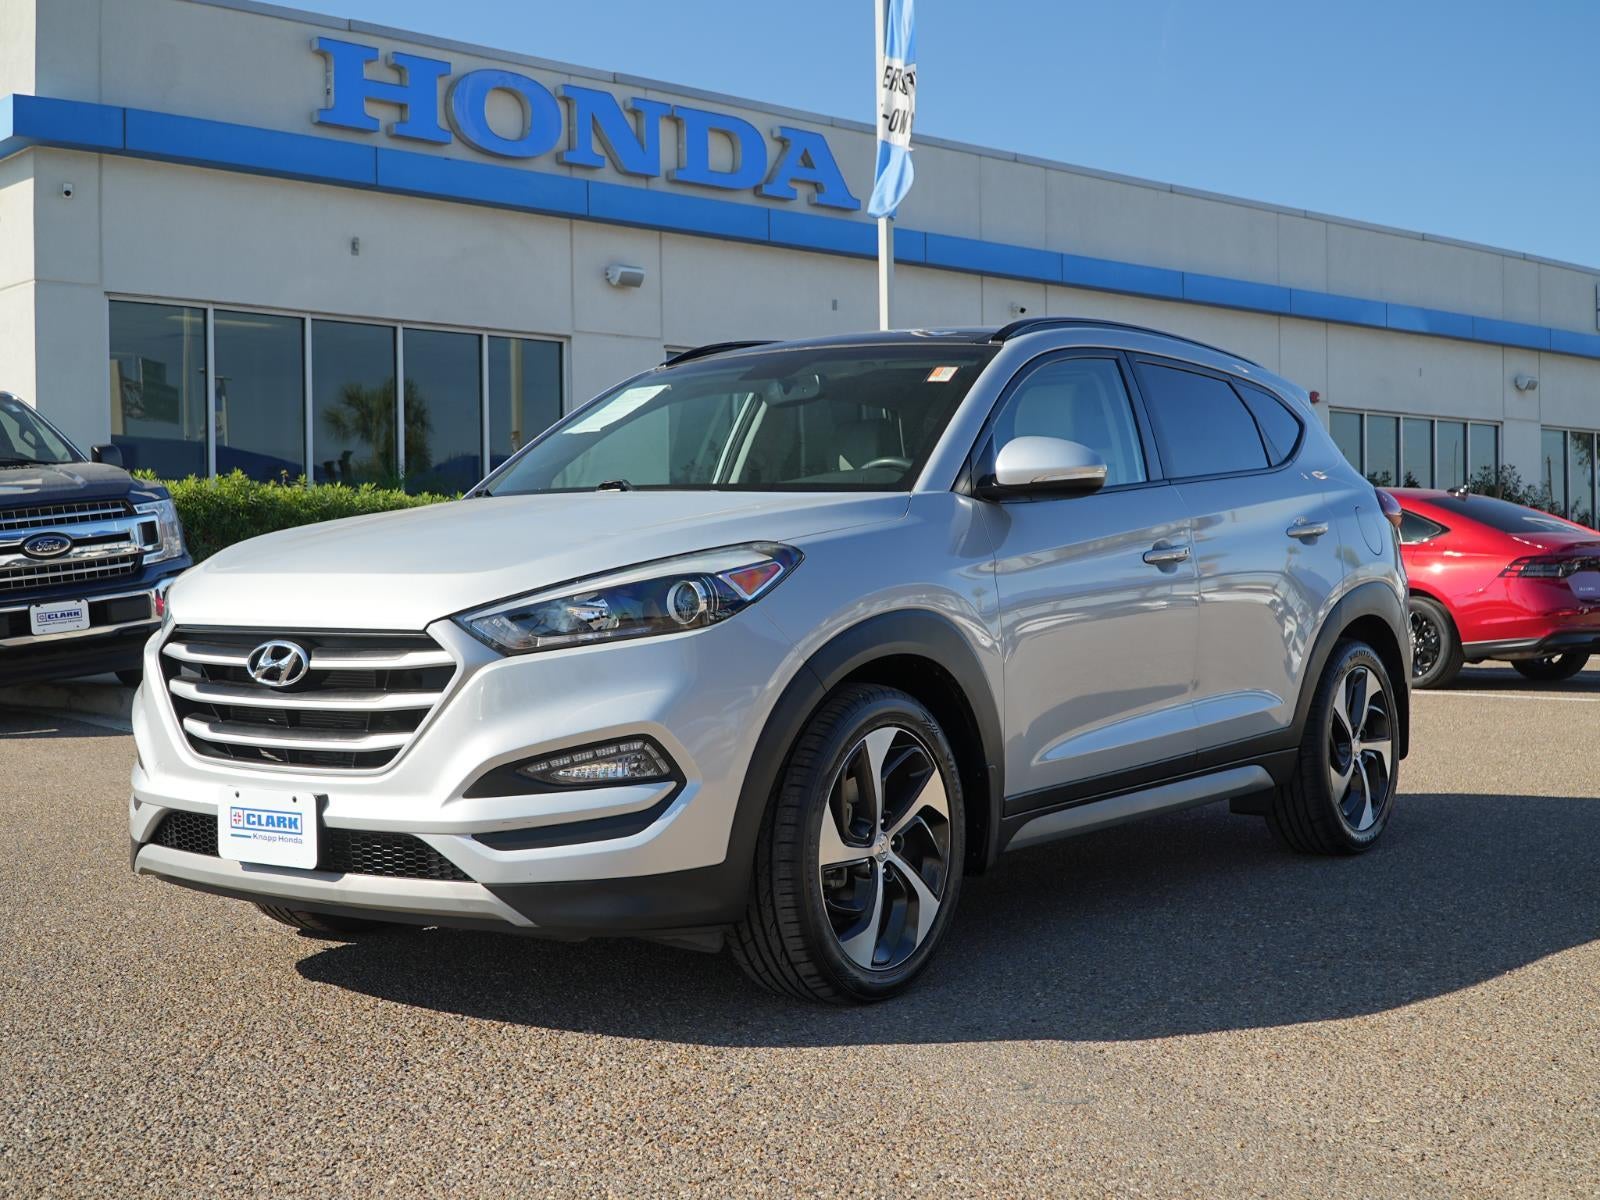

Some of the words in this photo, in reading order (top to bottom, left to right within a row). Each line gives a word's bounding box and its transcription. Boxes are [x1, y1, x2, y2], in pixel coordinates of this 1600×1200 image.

[311, 37, 861, 211] HONDA
[36, 540, 60, 552] Ford
[47, 610, 80, 620] CLARK
[246, 813, 299, 830] CLARK
[252, 833, 277, 842] Knapp
[278, 835, 303, 844] Honda
